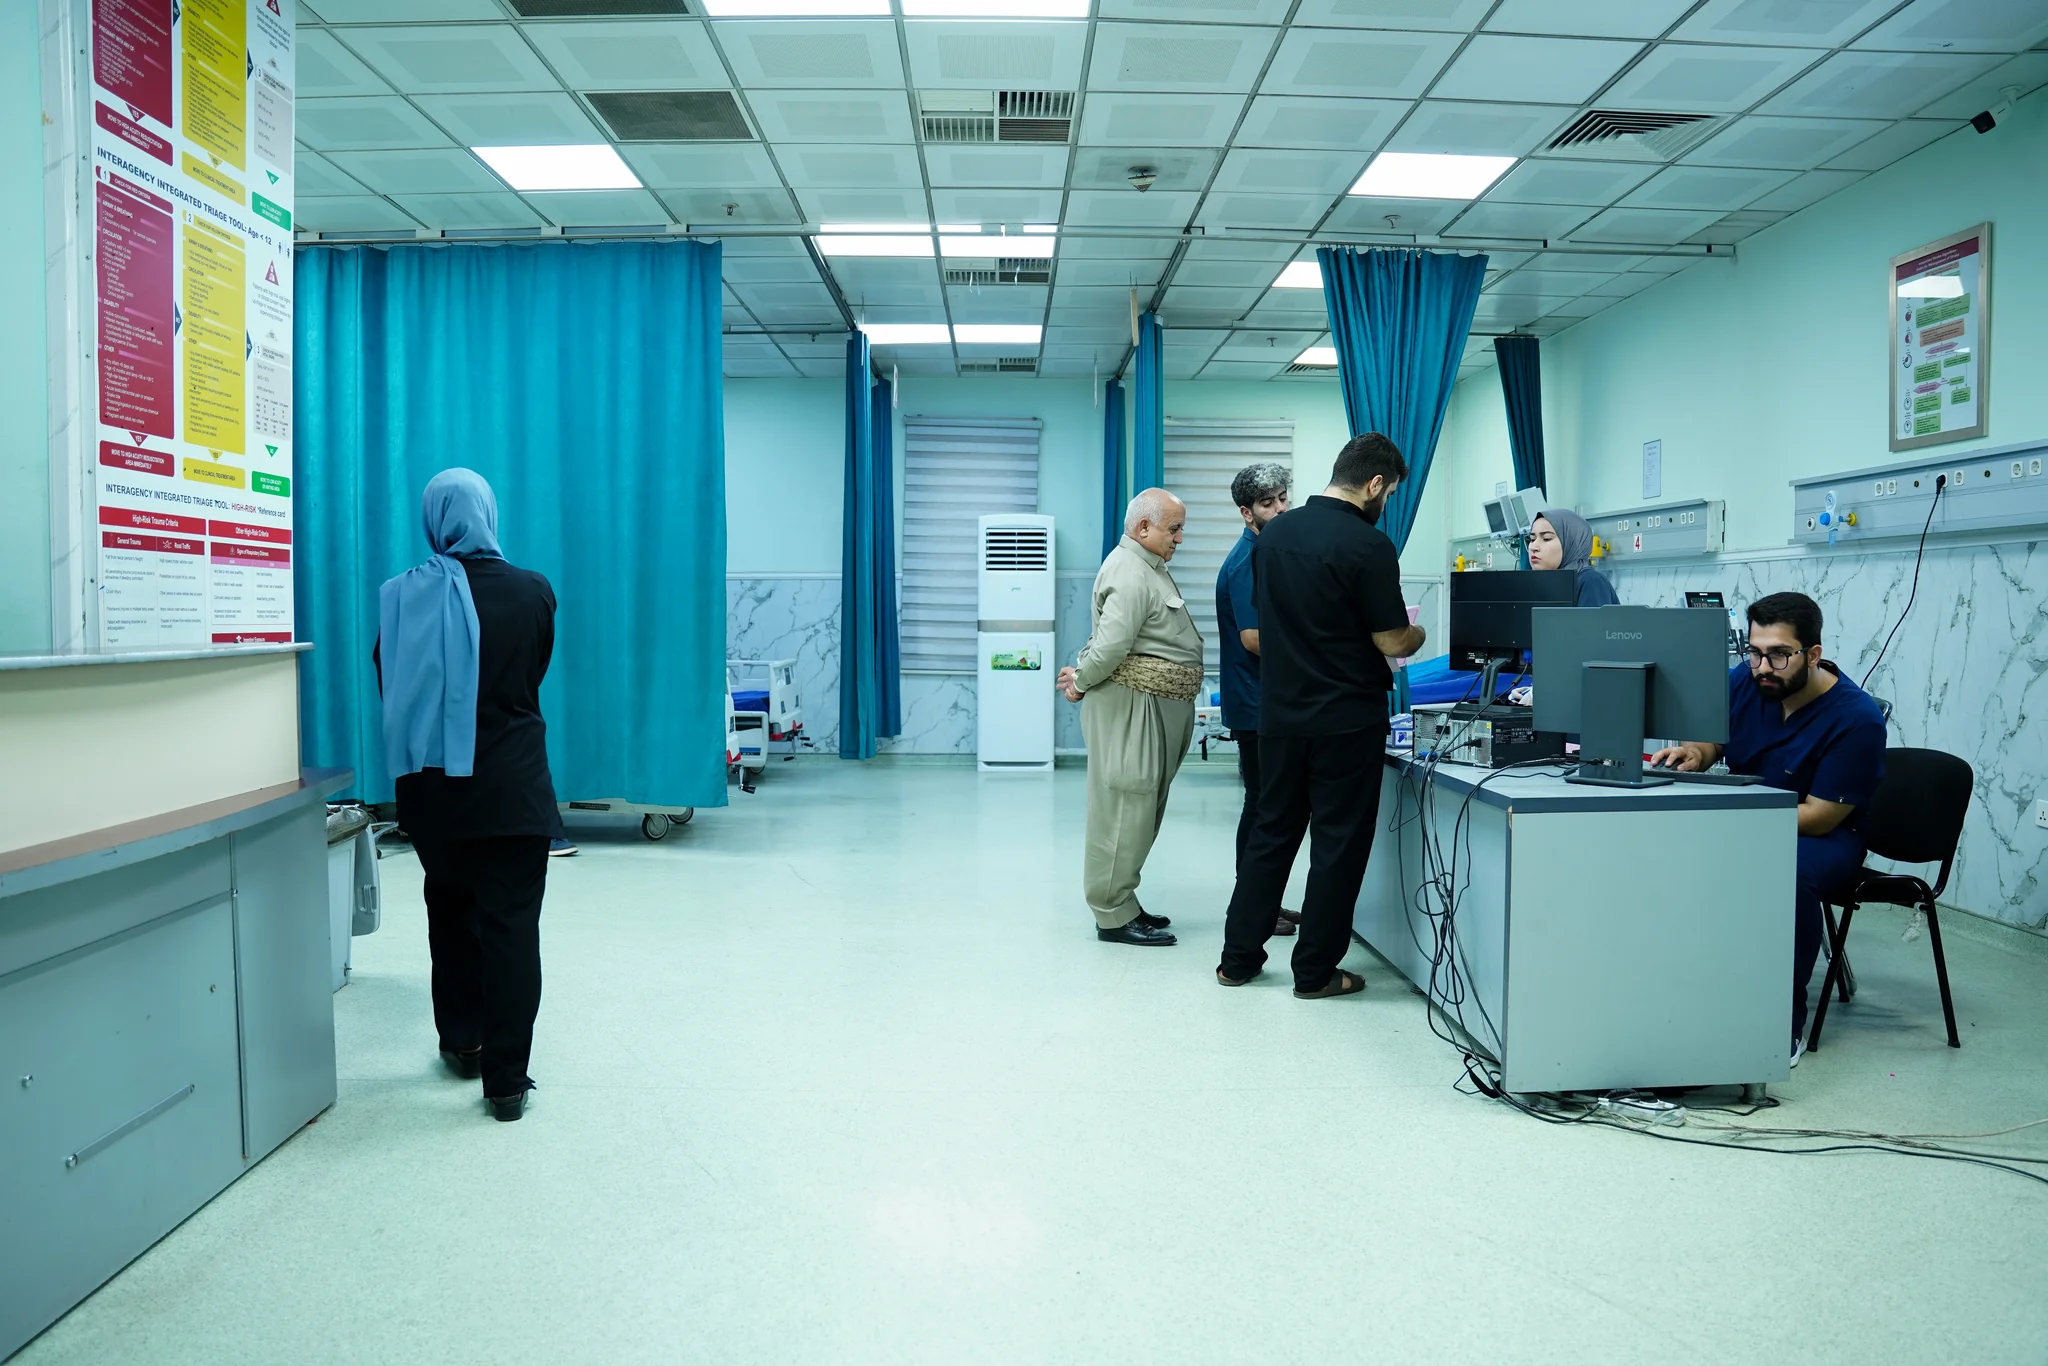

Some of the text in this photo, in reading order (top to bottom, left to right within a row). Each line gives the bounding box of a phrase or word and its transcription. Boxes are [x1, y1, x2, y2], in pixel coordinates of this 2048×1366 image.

[107, 113, 117, 125] MOVE
[117, 119, 121, 127] TO
[122, 122, 130, 132] HIGH
[130, 126, 140, 138] ACUITY
[97, 146, 155, 185] INTERAGENCY
[157, 177, 202, 210] INTEGRATED
[204, 202, 227, 223] TRIAGE
[229, 215, 246, 233] TOOL:
[248, 225, 259, 241] Age
[265, 234, 272, 246] 12
[103, 228, 122, 241] CIRCULATION
[103, 298, 119, 310] DISABILITY
[104, 344, 114, 353] OTHER
[106, 483, 153, 499] INTERAGENCY
[154, 490, 191, 504] INTEGRATED
[193, 496, 213, 508] TRIAGE
[214, 500, 230, 510] TOOL:
[231, 502, 256, 514] HIGH-RISK
[277, 509, 286, 518] card
[132, 514, 178, 527] High-Risk Trauma Criteria
[244, 528, 258, 537] High-Risk
[117, 537, 142, 546] General Trauma
[1635, 536, 1640, 550] 4
[1605, 630, 1643, 640] Lenovo
